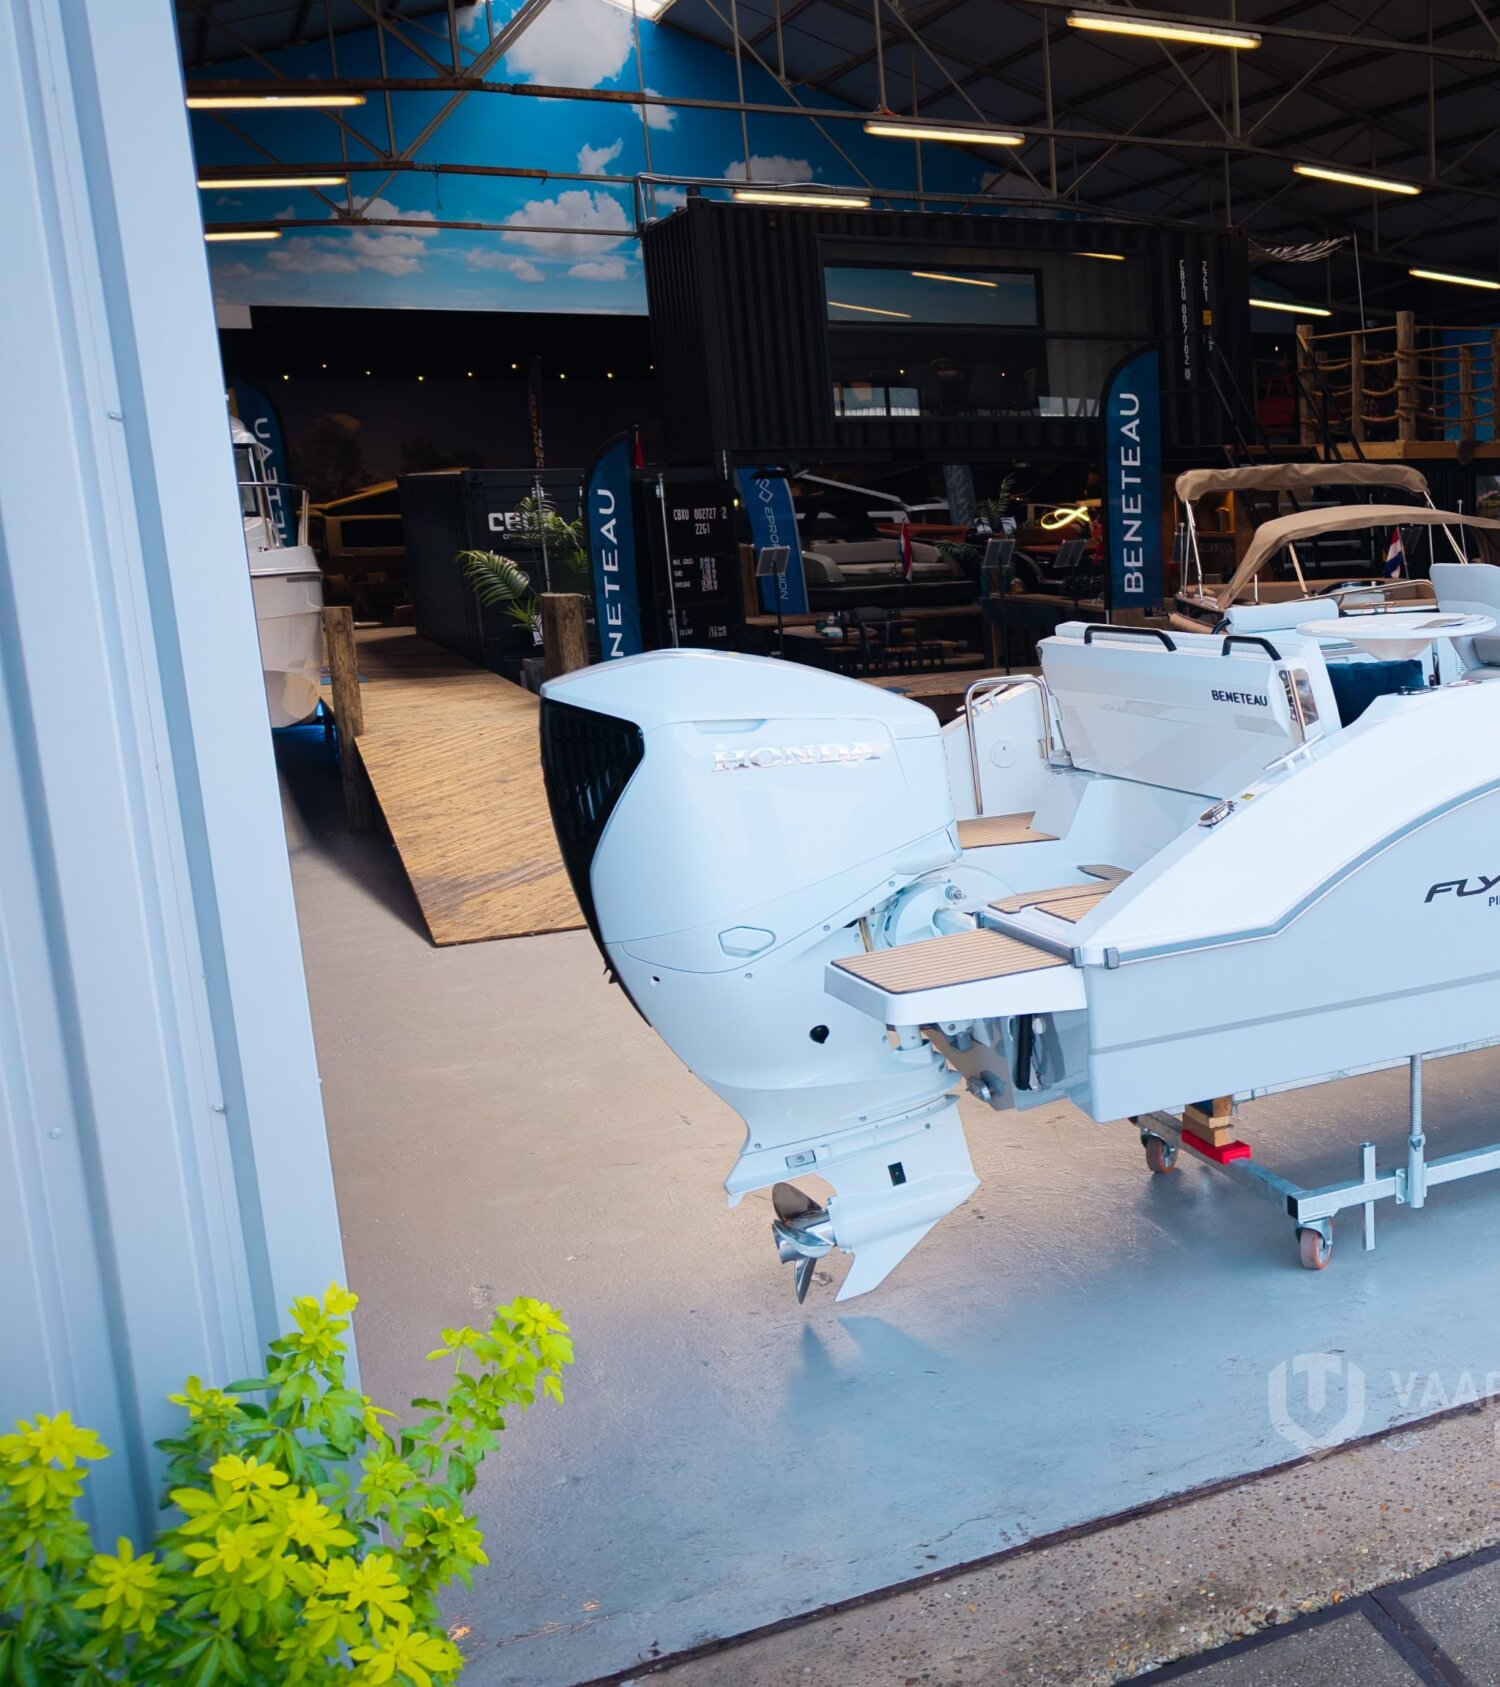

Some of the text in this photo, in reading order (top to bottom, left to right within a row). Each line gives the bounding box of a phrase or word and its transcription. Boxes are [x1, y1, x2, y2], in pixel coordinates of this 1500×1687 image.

[1119, 393, 1144, 593] BENETEAU
[597, 489, 624, 657] NETEAU
[1211, 690, 1268, 706] BENETEAU
[711, 742, 881, 772] HONDA
